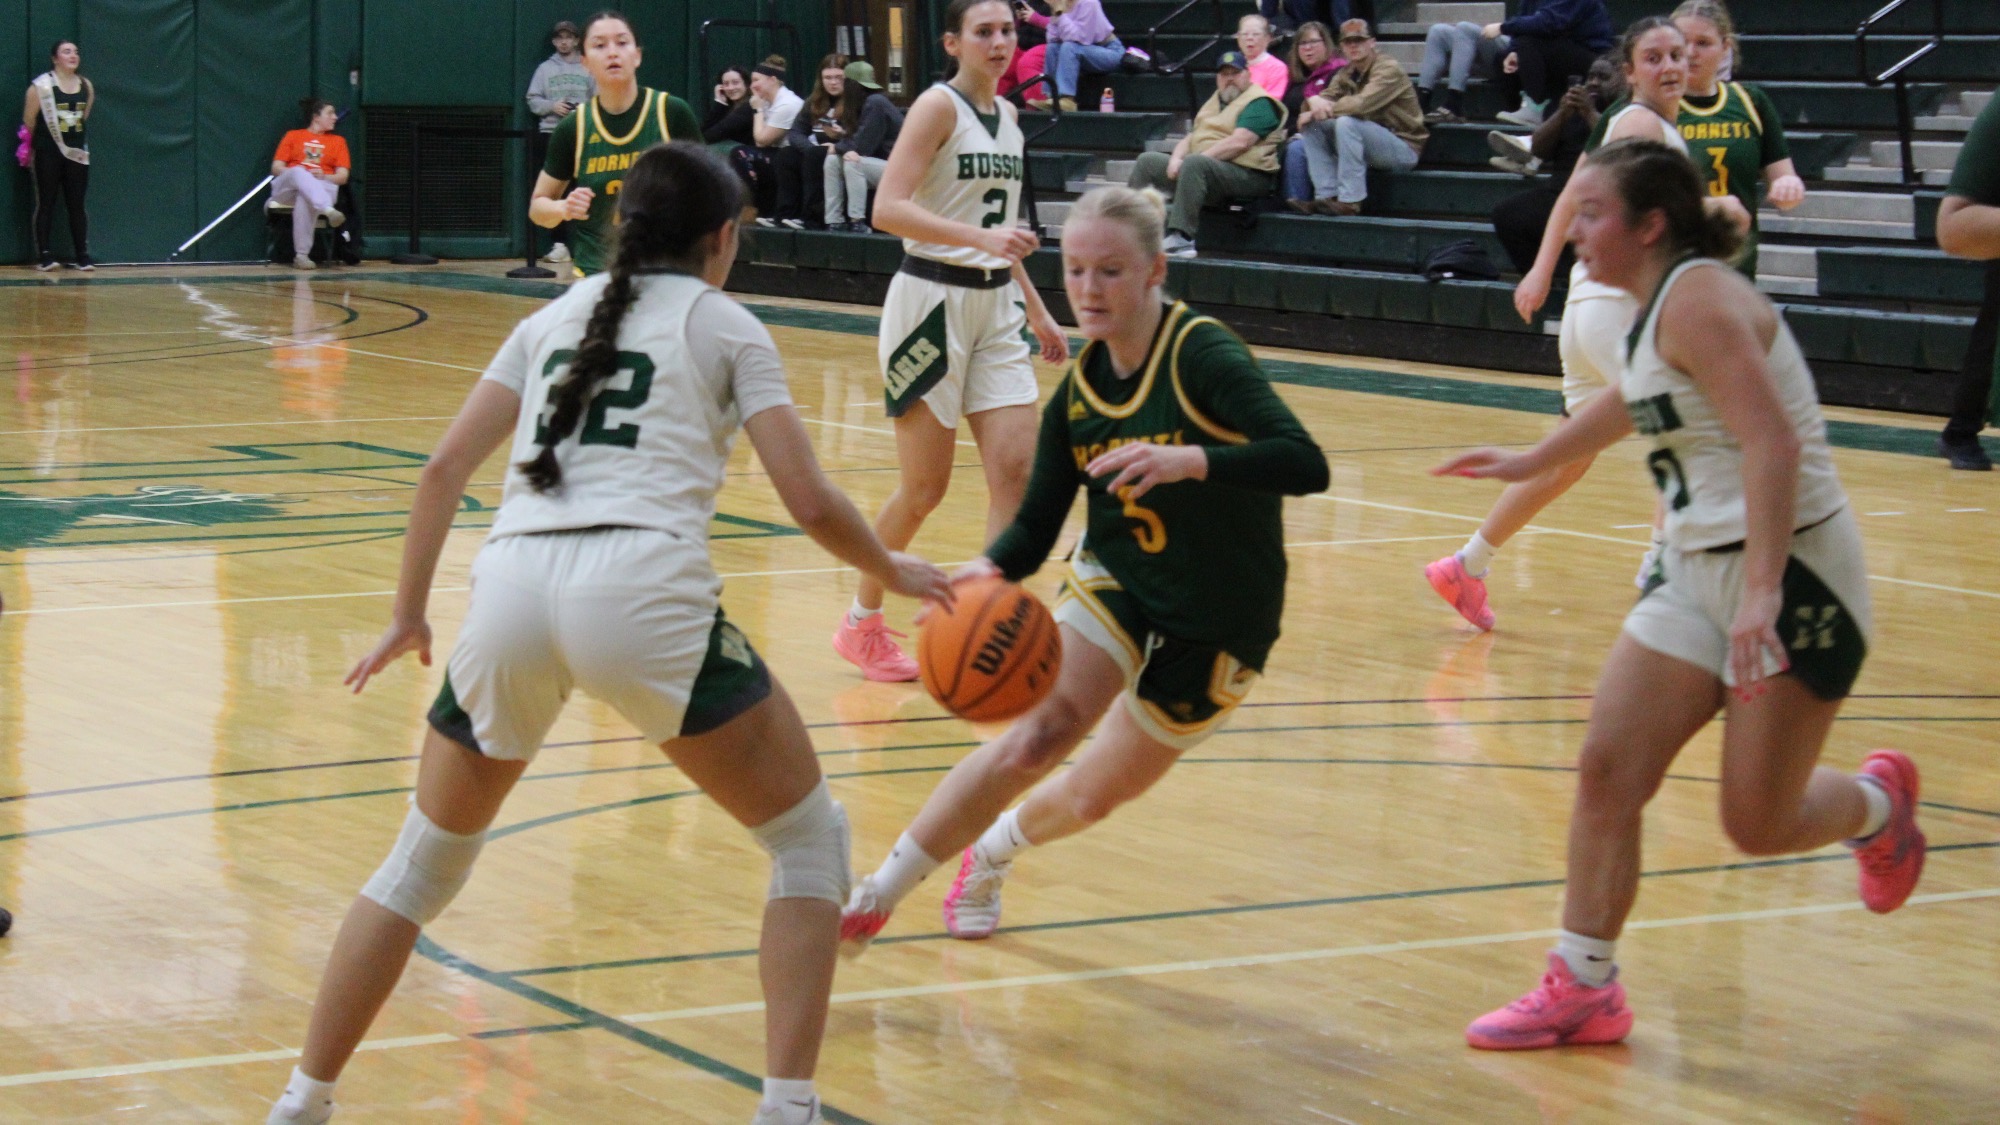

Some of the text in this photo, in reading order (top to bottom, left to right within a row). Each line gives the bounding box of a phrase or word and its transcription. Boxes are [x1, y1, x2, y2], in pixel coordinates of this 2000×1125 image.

[585, 151, 641, 175] HORNE
[957, 152, 1024, 181] HUSSO
[1706, 147, 1729, 197] 3
[981, 188, 1008, 229] 2
[885, 337, 941, 401] EAGLES
[1117, 485, 1167, 554] 5
[971, 595, 1032, 676] Wilson
